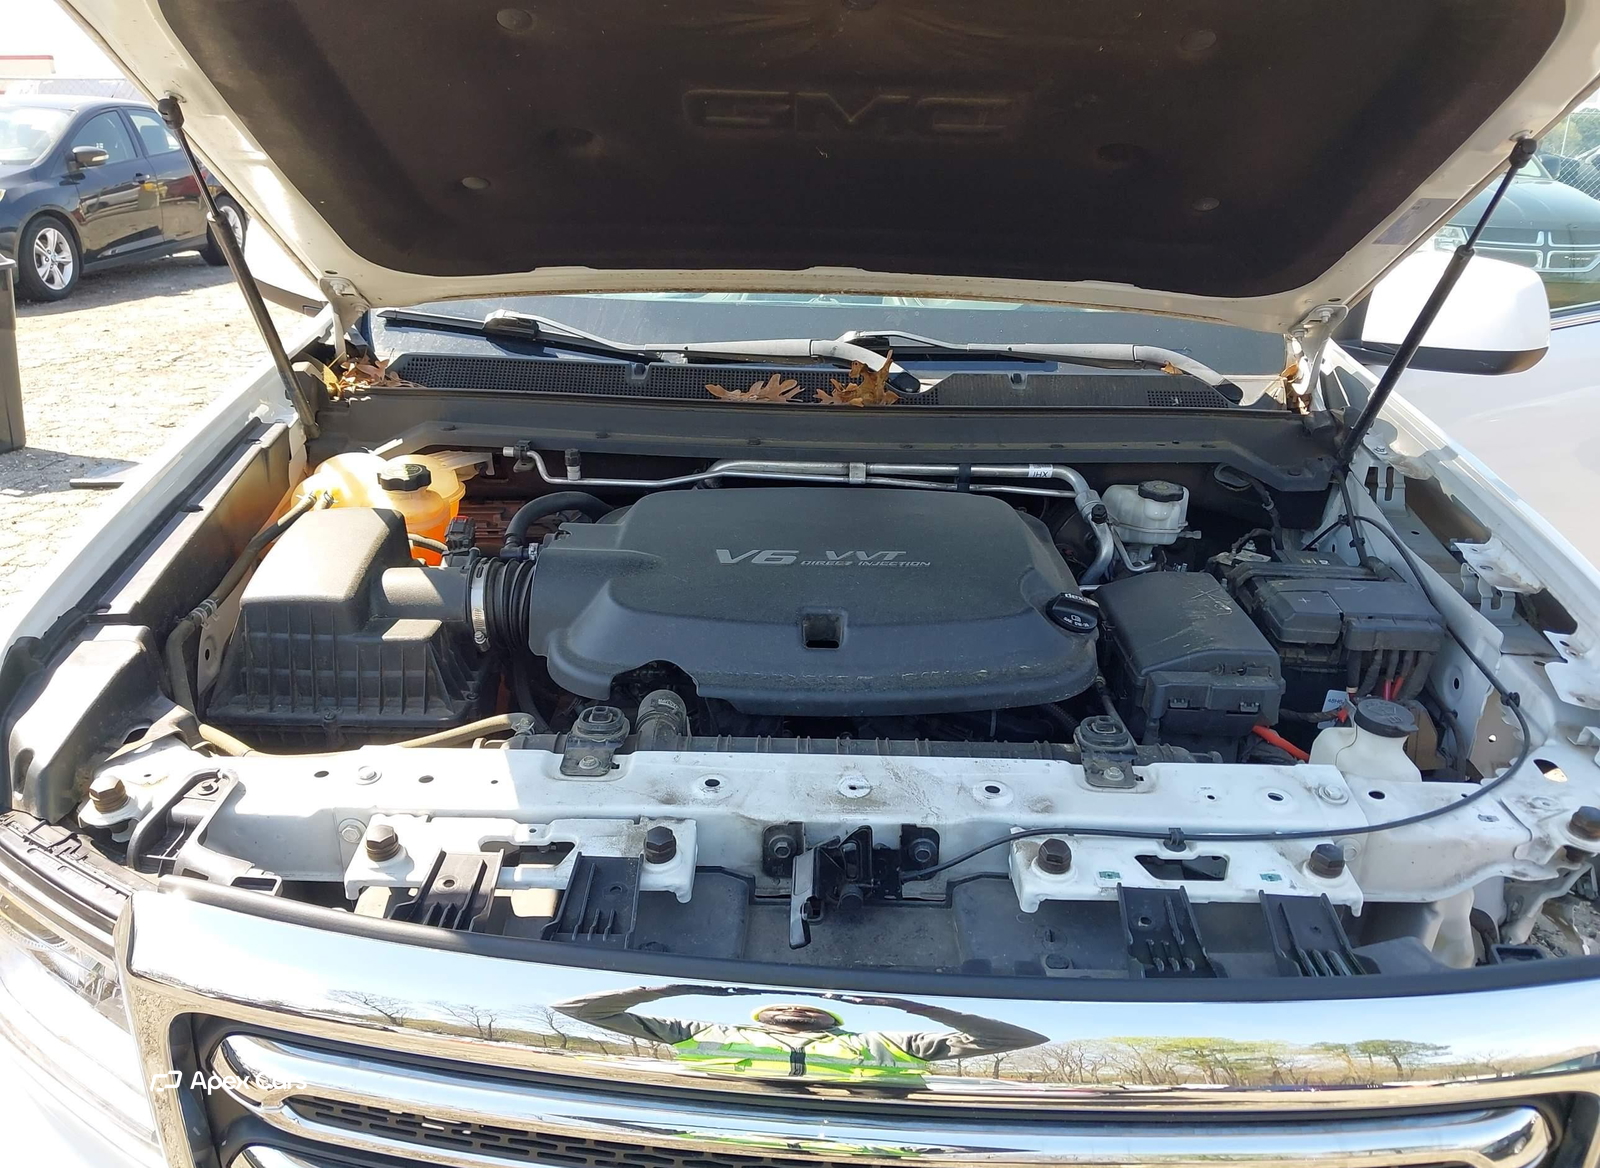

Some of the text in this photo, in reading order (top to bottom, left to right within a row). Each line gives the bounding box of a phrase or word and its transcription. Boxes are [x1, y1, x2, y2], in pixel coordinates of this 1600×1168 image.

[681, 87, 1018, 138] GMC
[716, 548, 907, 565] V6 VVT
